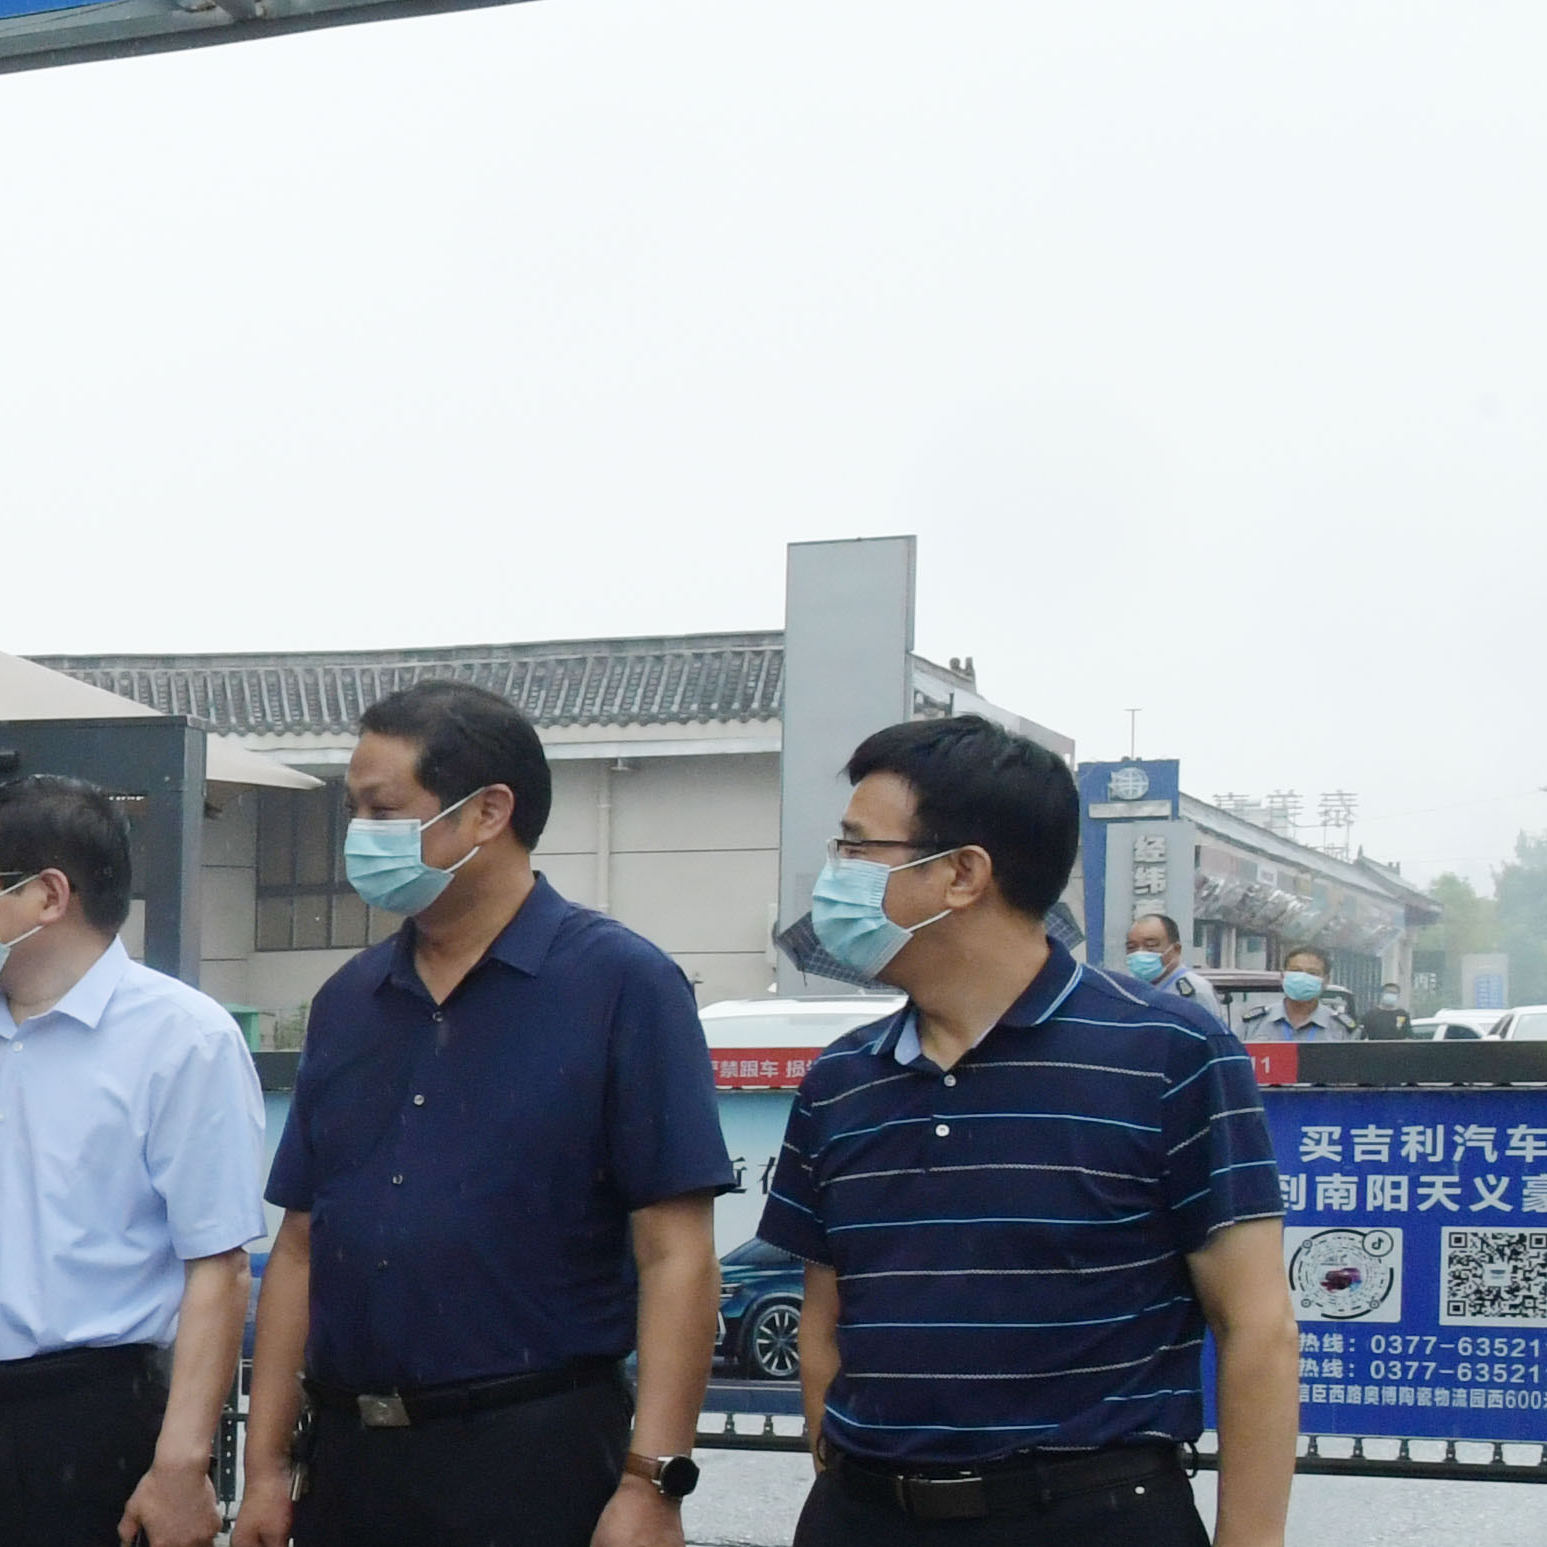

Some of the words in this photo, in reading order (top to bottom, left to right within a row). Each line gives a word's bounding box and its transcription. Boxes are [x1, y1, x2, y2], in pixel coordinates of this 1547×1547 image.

[1299, 1124, 1547, 1163] 买吉利汽车
[1370, 1334, 1547, 1358] 0377-63521
[1370, 1360, 1547, 1384] 0377-63521
[1299, 1383, 1547, 1410] 信臣西路奥博陶瓷物流园西600
